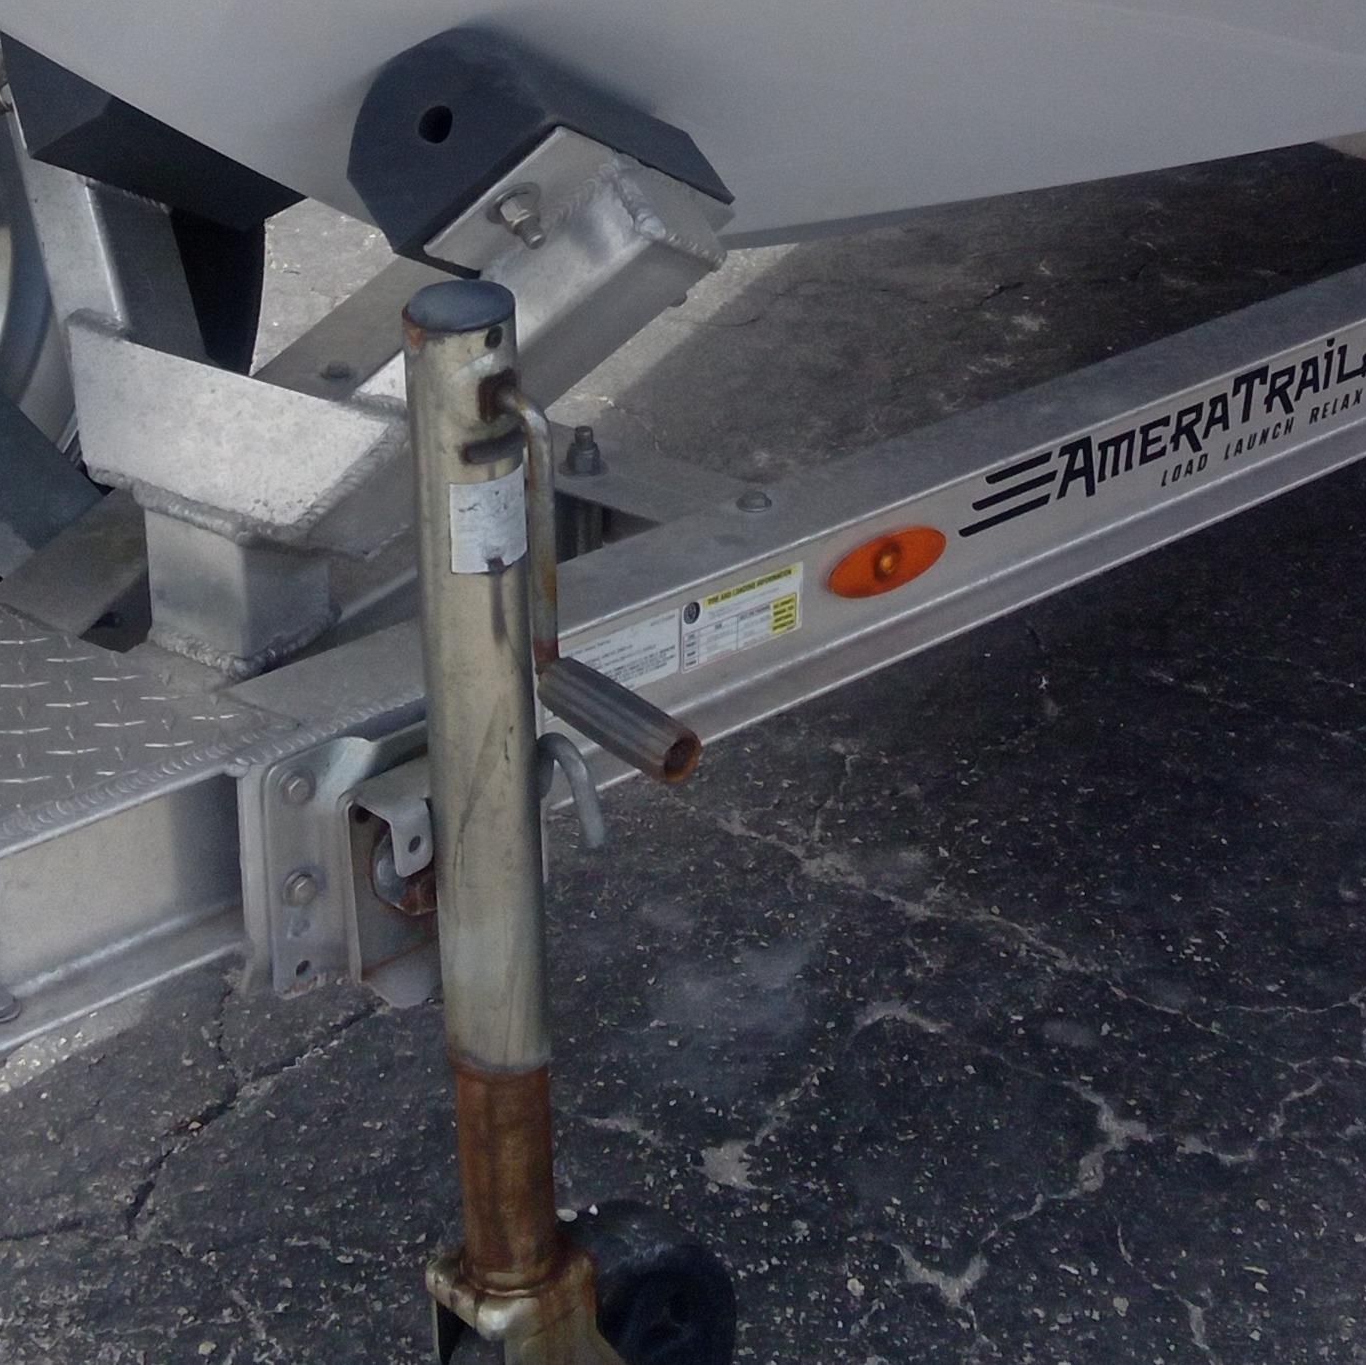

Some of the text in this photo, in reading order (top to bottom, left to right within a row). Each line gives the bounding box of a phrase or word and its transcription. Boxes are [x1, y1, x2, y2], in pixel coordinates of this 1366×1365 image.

[1161, 388, 1365, 487] LOAD LAUNCH RELAX
